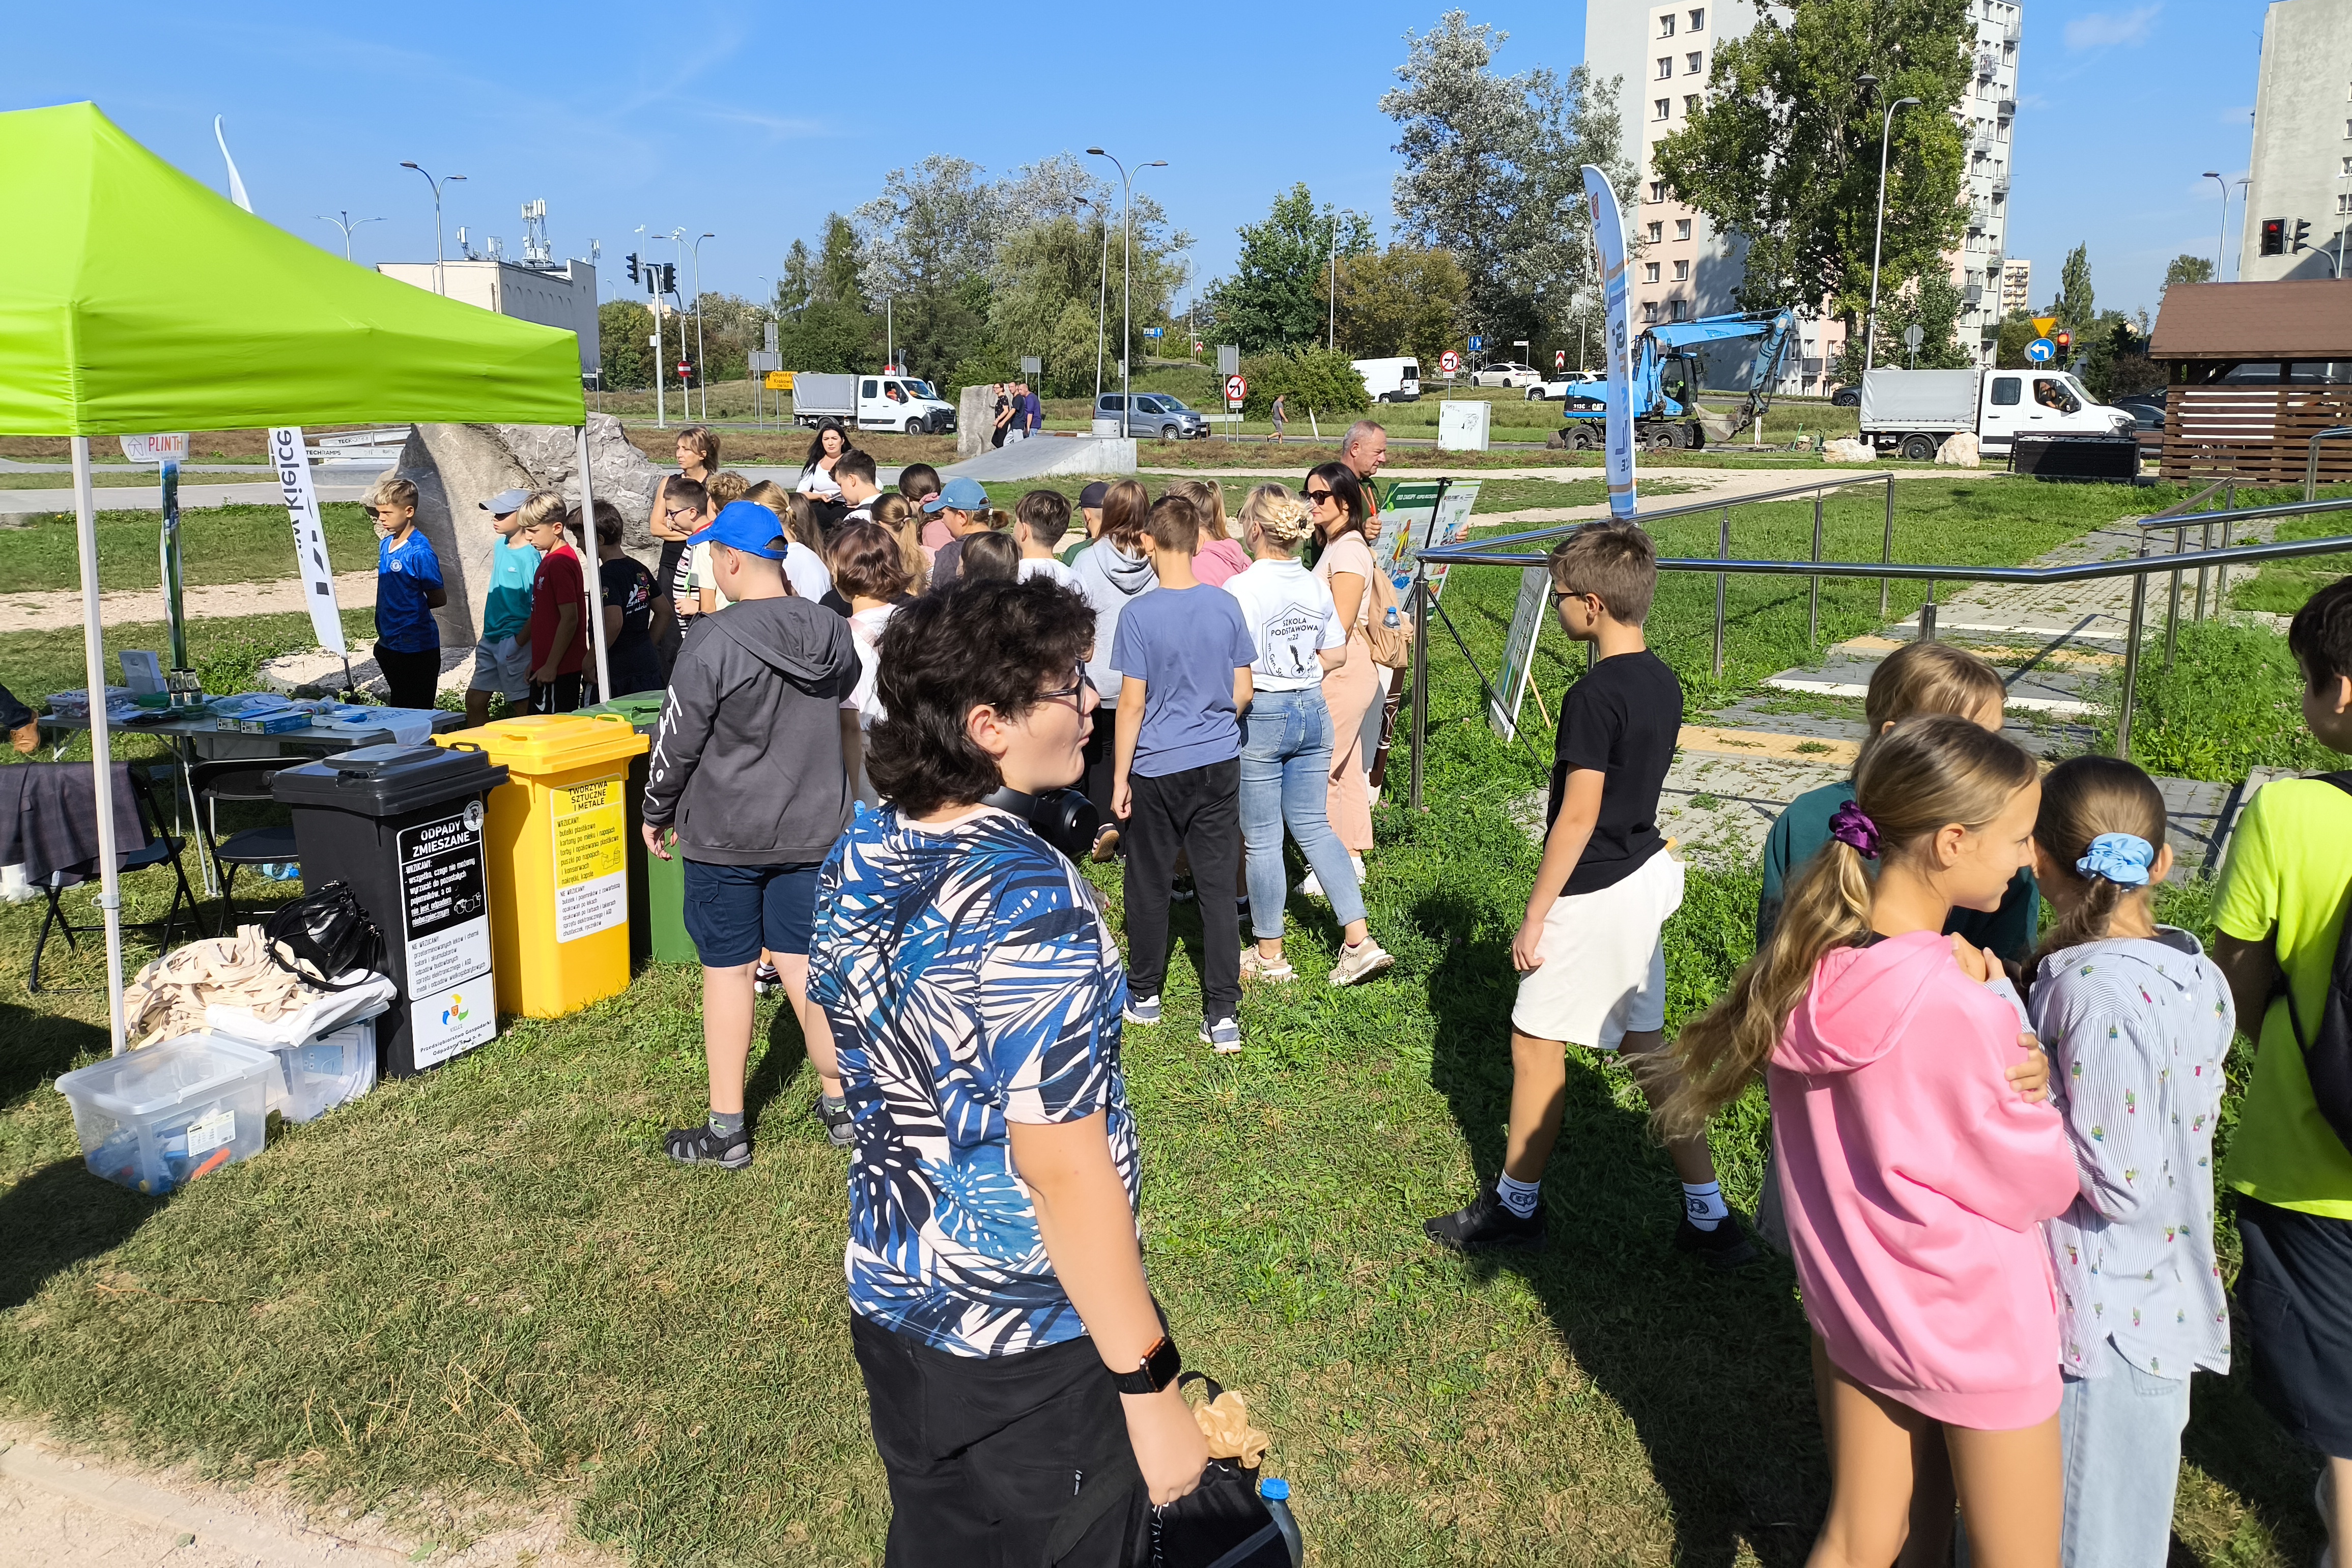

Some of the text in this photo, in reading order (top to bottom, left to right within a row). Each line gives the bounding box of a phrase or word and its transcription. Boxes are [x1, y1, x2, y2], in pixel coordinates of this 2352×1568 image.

[149, 435, 183, 452] PLINTH
[277, 430, 304, 510] kielce
[1271, 624, 1318, 636] PODSTAWOWA
[569, 780, 608, 795] TWORZYWA
[571, 788, 606, 804] SZTUCZNE
[578, 797, 605, 810] METALE
[420, 820, 461, 841] ODPADY
[412, 831, 470, 858] ZMIESZANE
[434, 866, 448, 876] czego
[457, 858, 475, 869] możemy
[433, 879, 439, 888] do
[431, 897, 452, 909] odpadem
[412, 908, 449, 926] niebezpiecznym
[465, 1020, 491, 1035] Gospodarki
